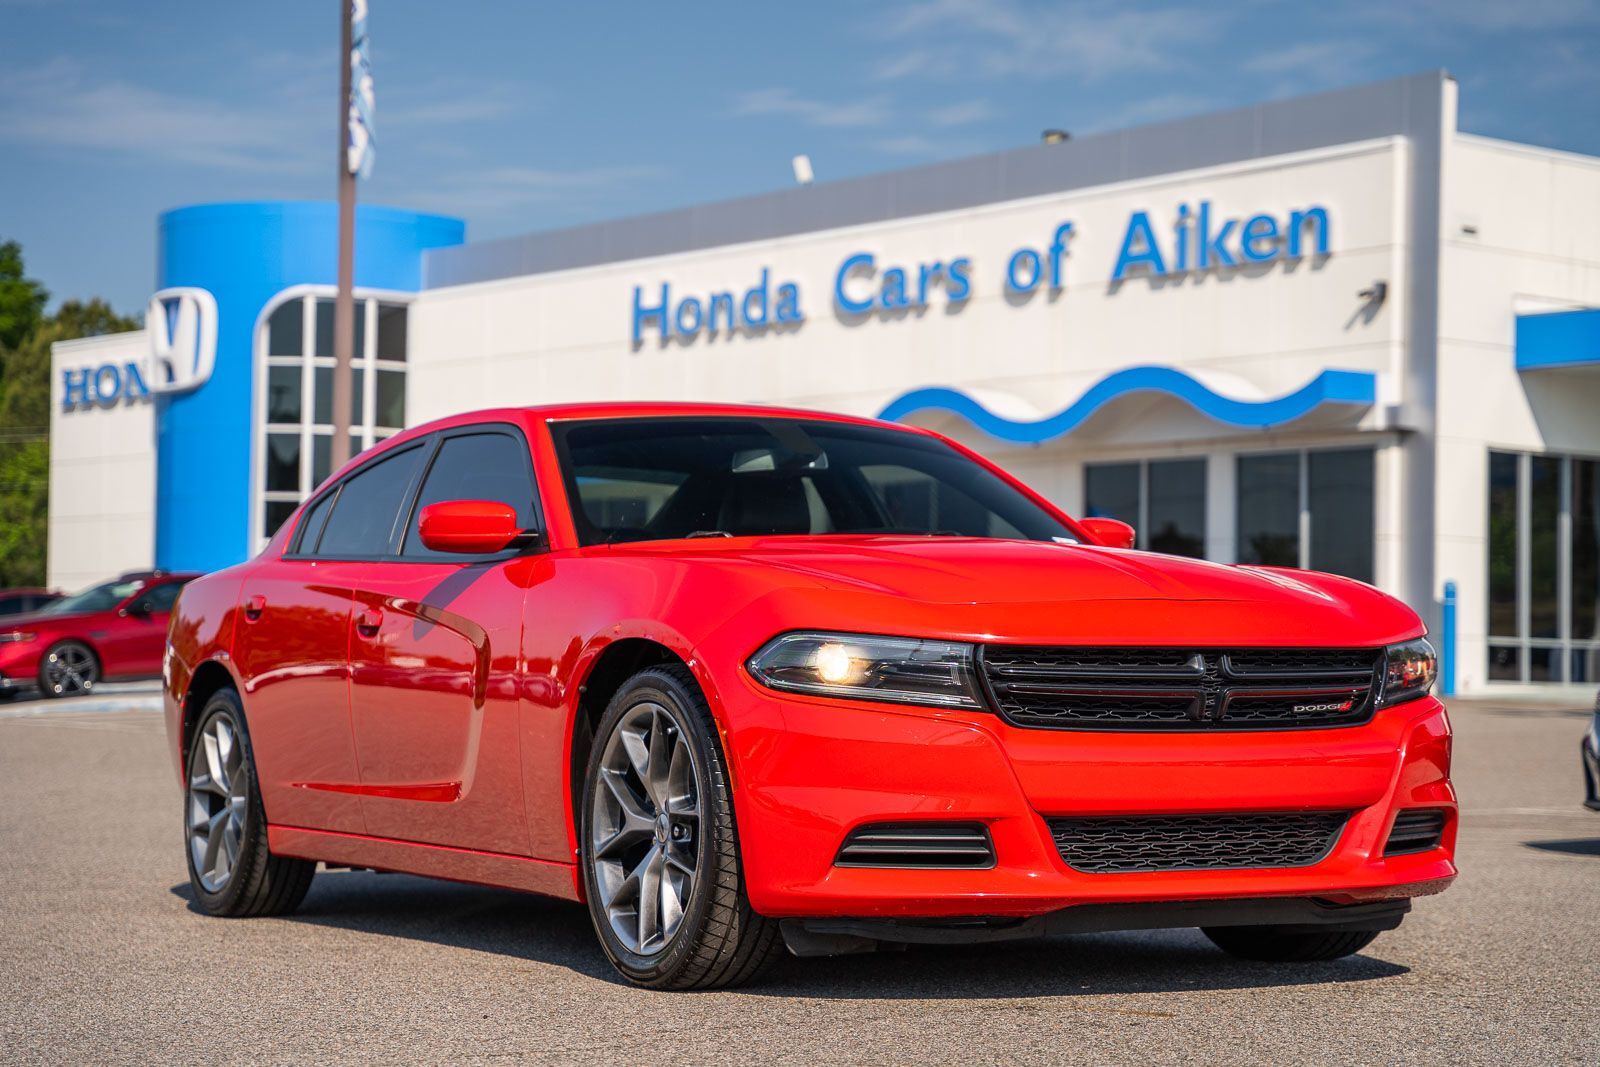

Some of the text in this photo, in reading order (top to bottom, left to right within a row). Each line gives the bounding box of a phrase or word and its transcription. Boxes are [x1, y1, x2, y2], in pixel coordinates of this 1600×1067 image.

[632, 200, 1330, 342] Honda Cars of Aiken
[1293, 703, 1347, 712] DODGE
